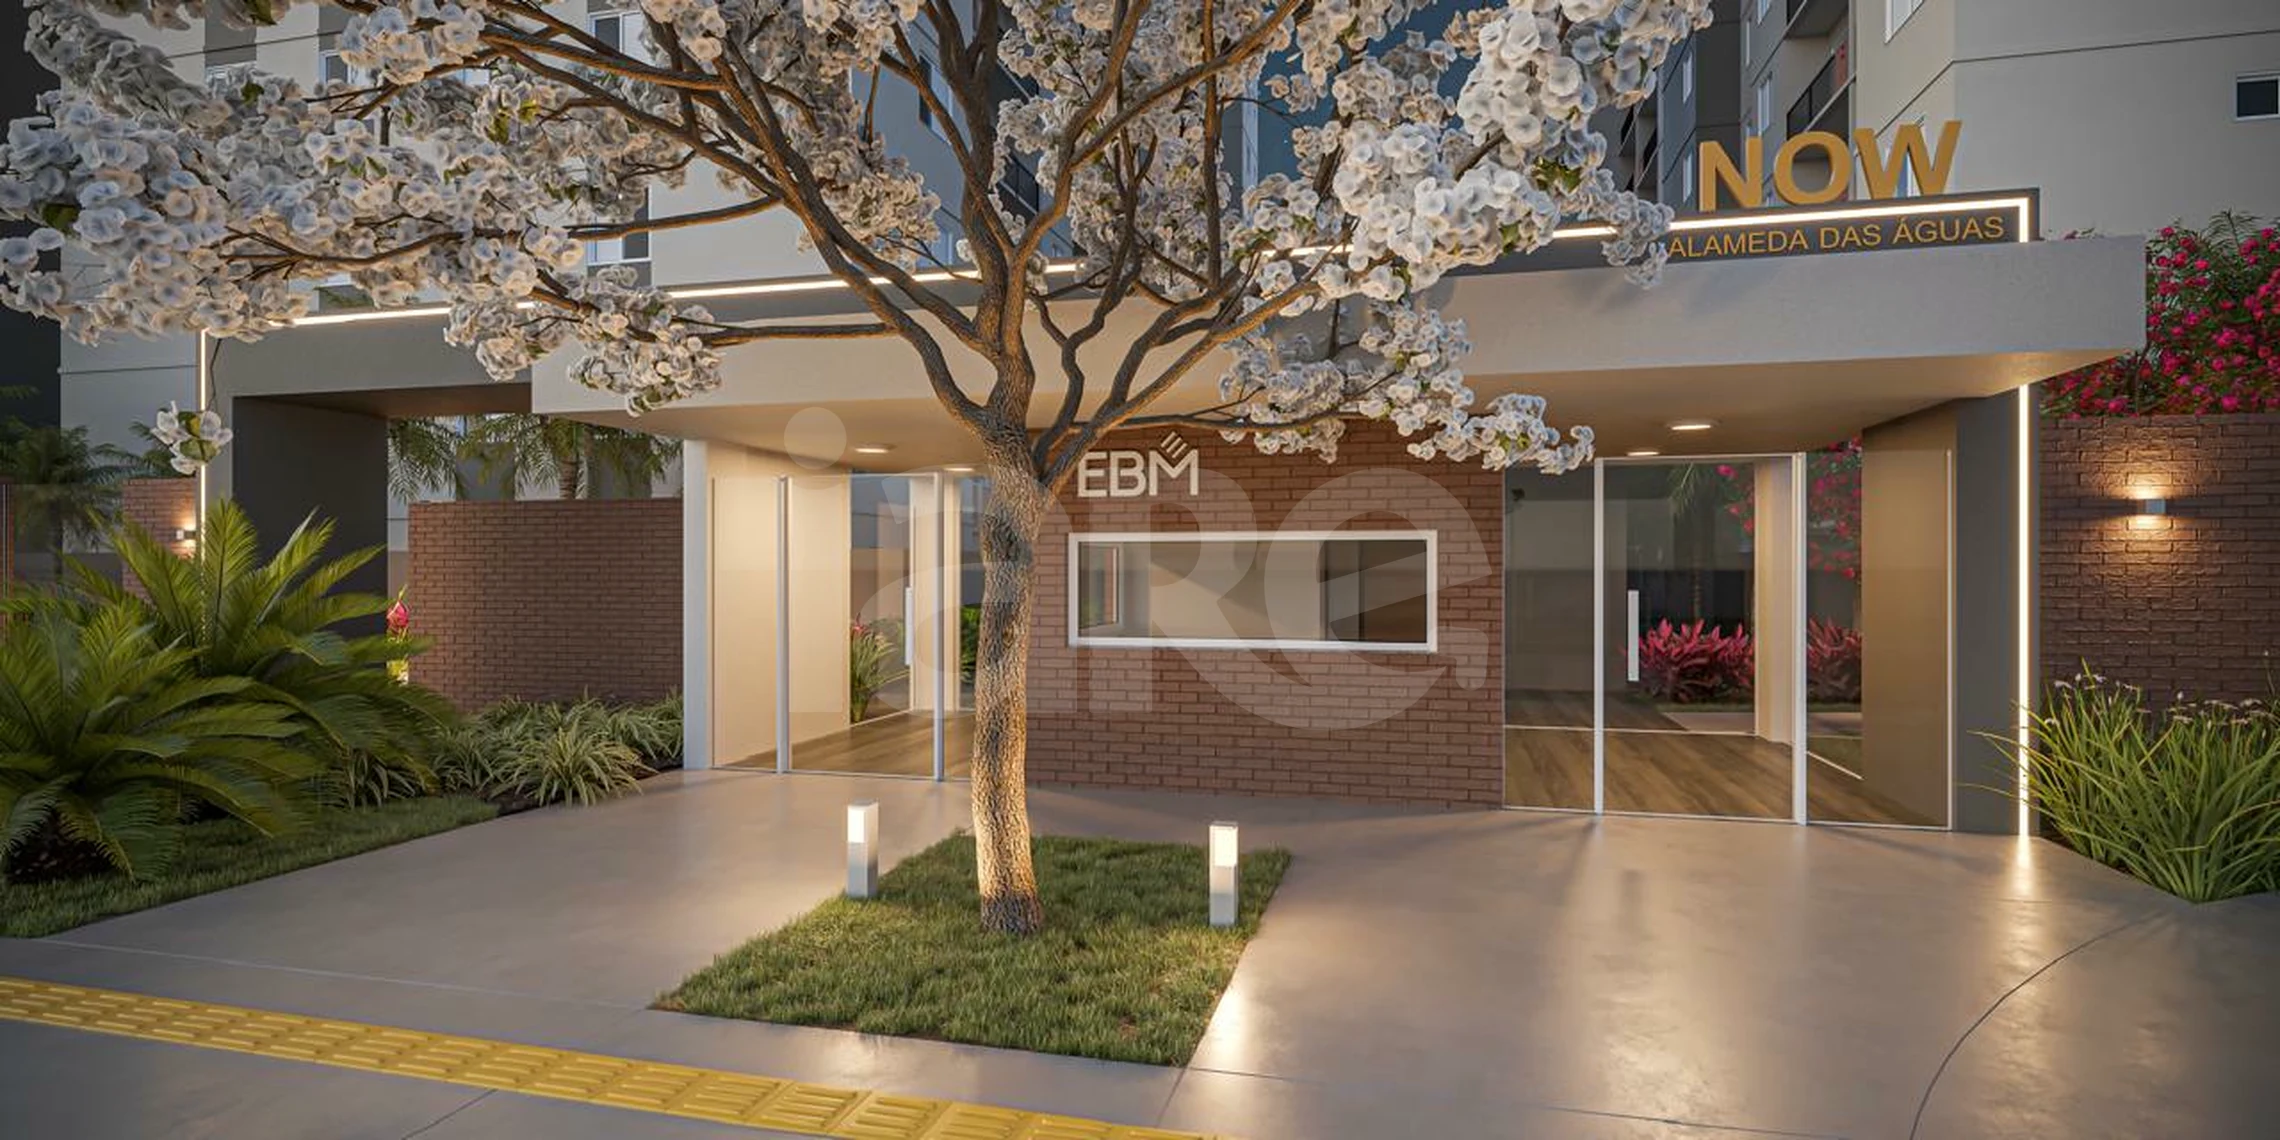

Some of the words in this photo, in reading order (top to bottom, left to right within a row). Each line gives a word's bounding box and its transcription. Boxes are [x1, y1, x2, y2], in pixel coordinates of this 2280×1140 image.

[1699, 120, 1963, 213] NOW
[1668, 229, 1809, 258] ALAMEDA
[1820, 224, 1882, 249] DAS
[1892, 216, 2005, 244] ÁGUAS
[1077, 449, 1199, 498] EBM
